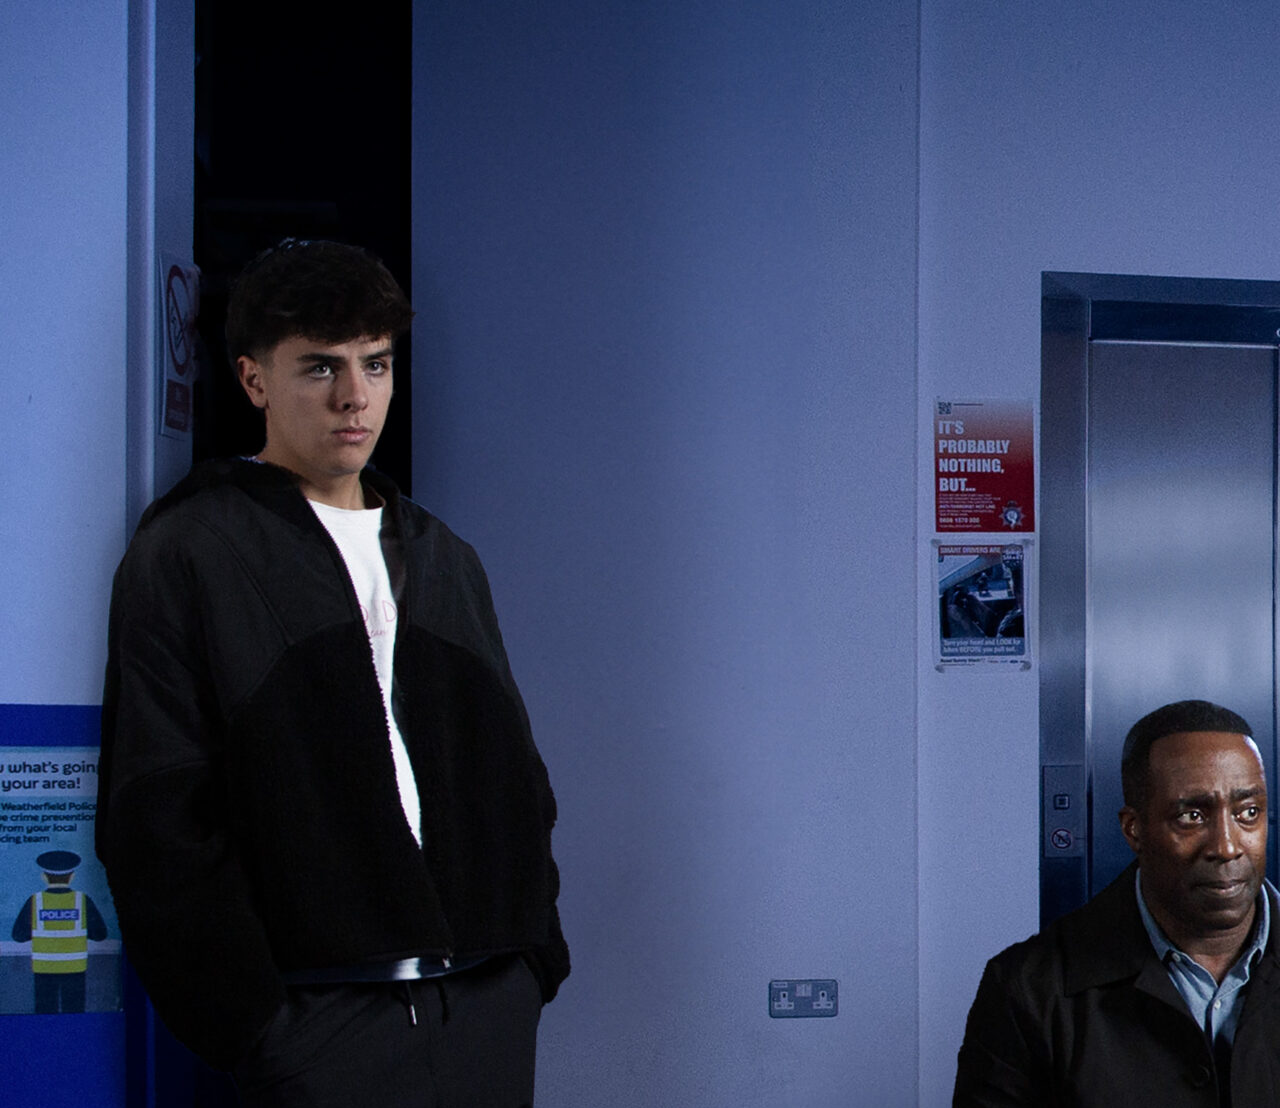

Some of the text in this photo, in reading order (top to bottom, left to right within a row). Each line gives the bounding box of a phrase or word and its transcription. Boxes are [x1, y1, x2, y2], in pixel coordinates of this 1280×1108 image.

[938, 420, 965, 434] IT'S
[938, 440, 1010, 454] PROBABLY
[8, 761, 59, 773] what's
[1, 777, 80, 792] your area!
[1, 802, 66, 811] Weatherfield
[10, 813, 39, 822] crime
[26, 825, 51, 834] your
[52, 823, 77, 832] local
[22, 834, 50, 843] team
[41, 910, 77, 919] POLICE
